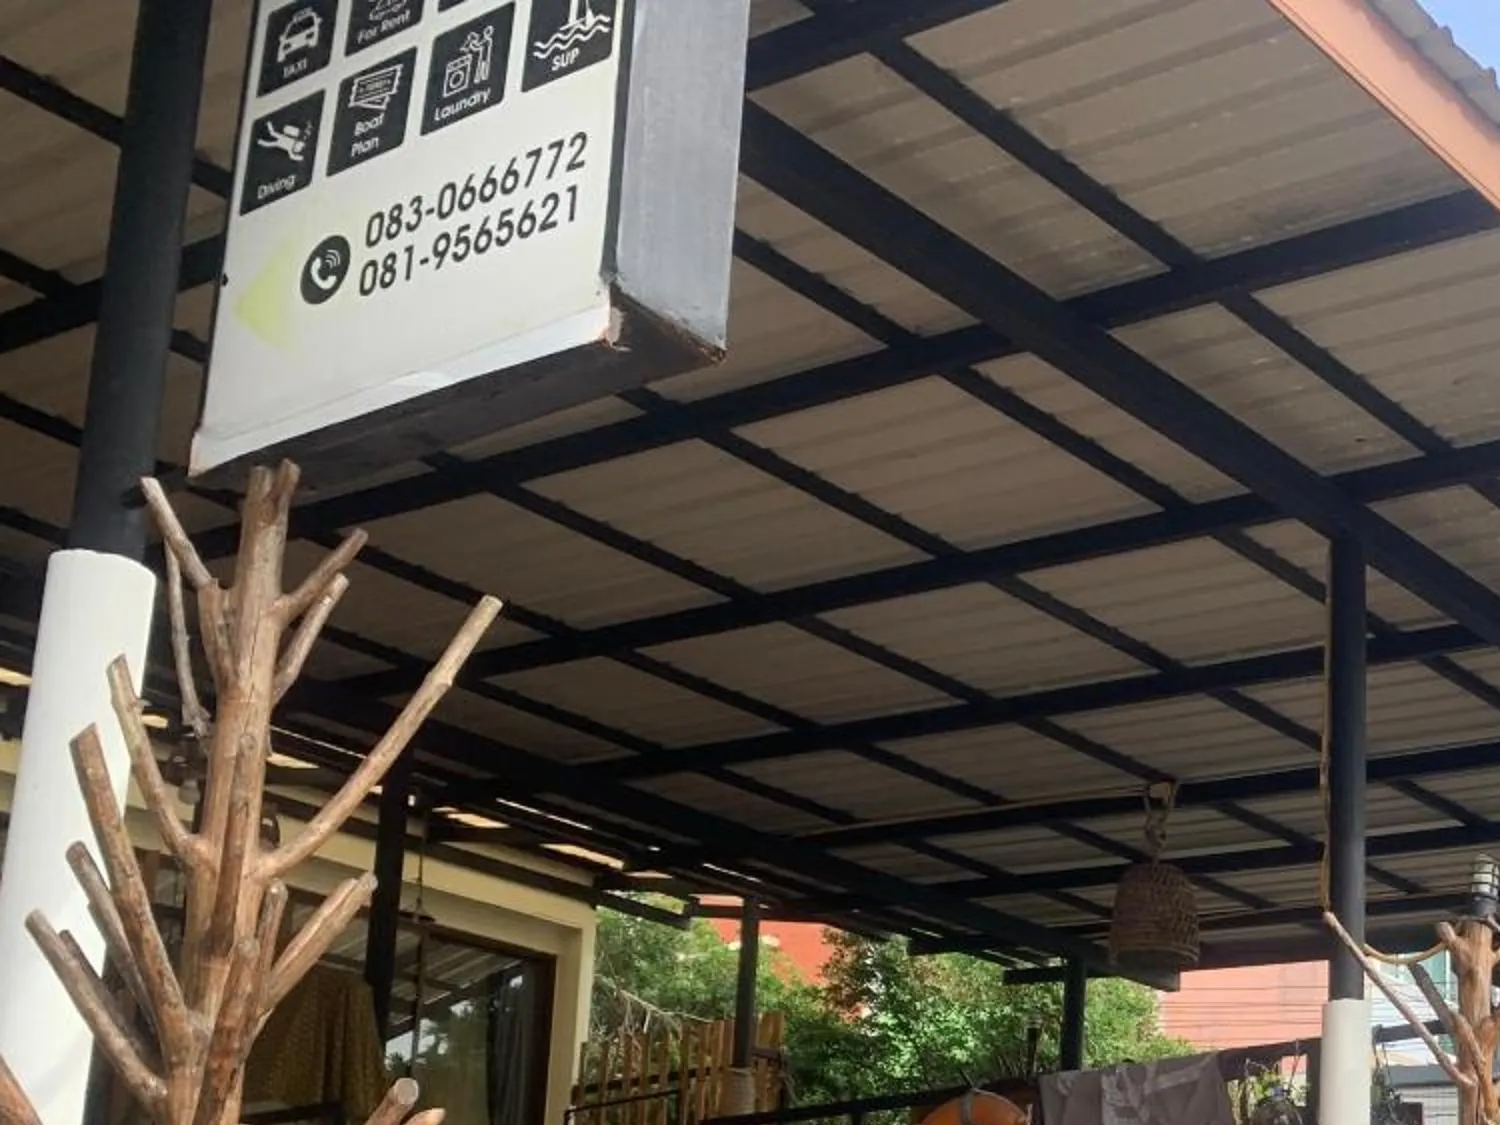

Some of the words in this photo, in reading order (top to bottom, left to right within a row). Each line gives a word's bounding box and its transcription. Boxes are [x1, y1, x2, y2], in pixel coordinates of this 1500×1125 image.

[357, 28, 378, 44] For
[380, 10, 411, 33] Rent
[551, 48, 581, 72] SUP
[433, 87, 491, 121] Laundry
[354, 112, 385, 137] Boat
[351, 137, 380, 157] Plan
[257, 174, 297, 200] Diving
[365, 130, 588, 248] 083-0666772
[358, 184, 578, 297] 081-9565621
